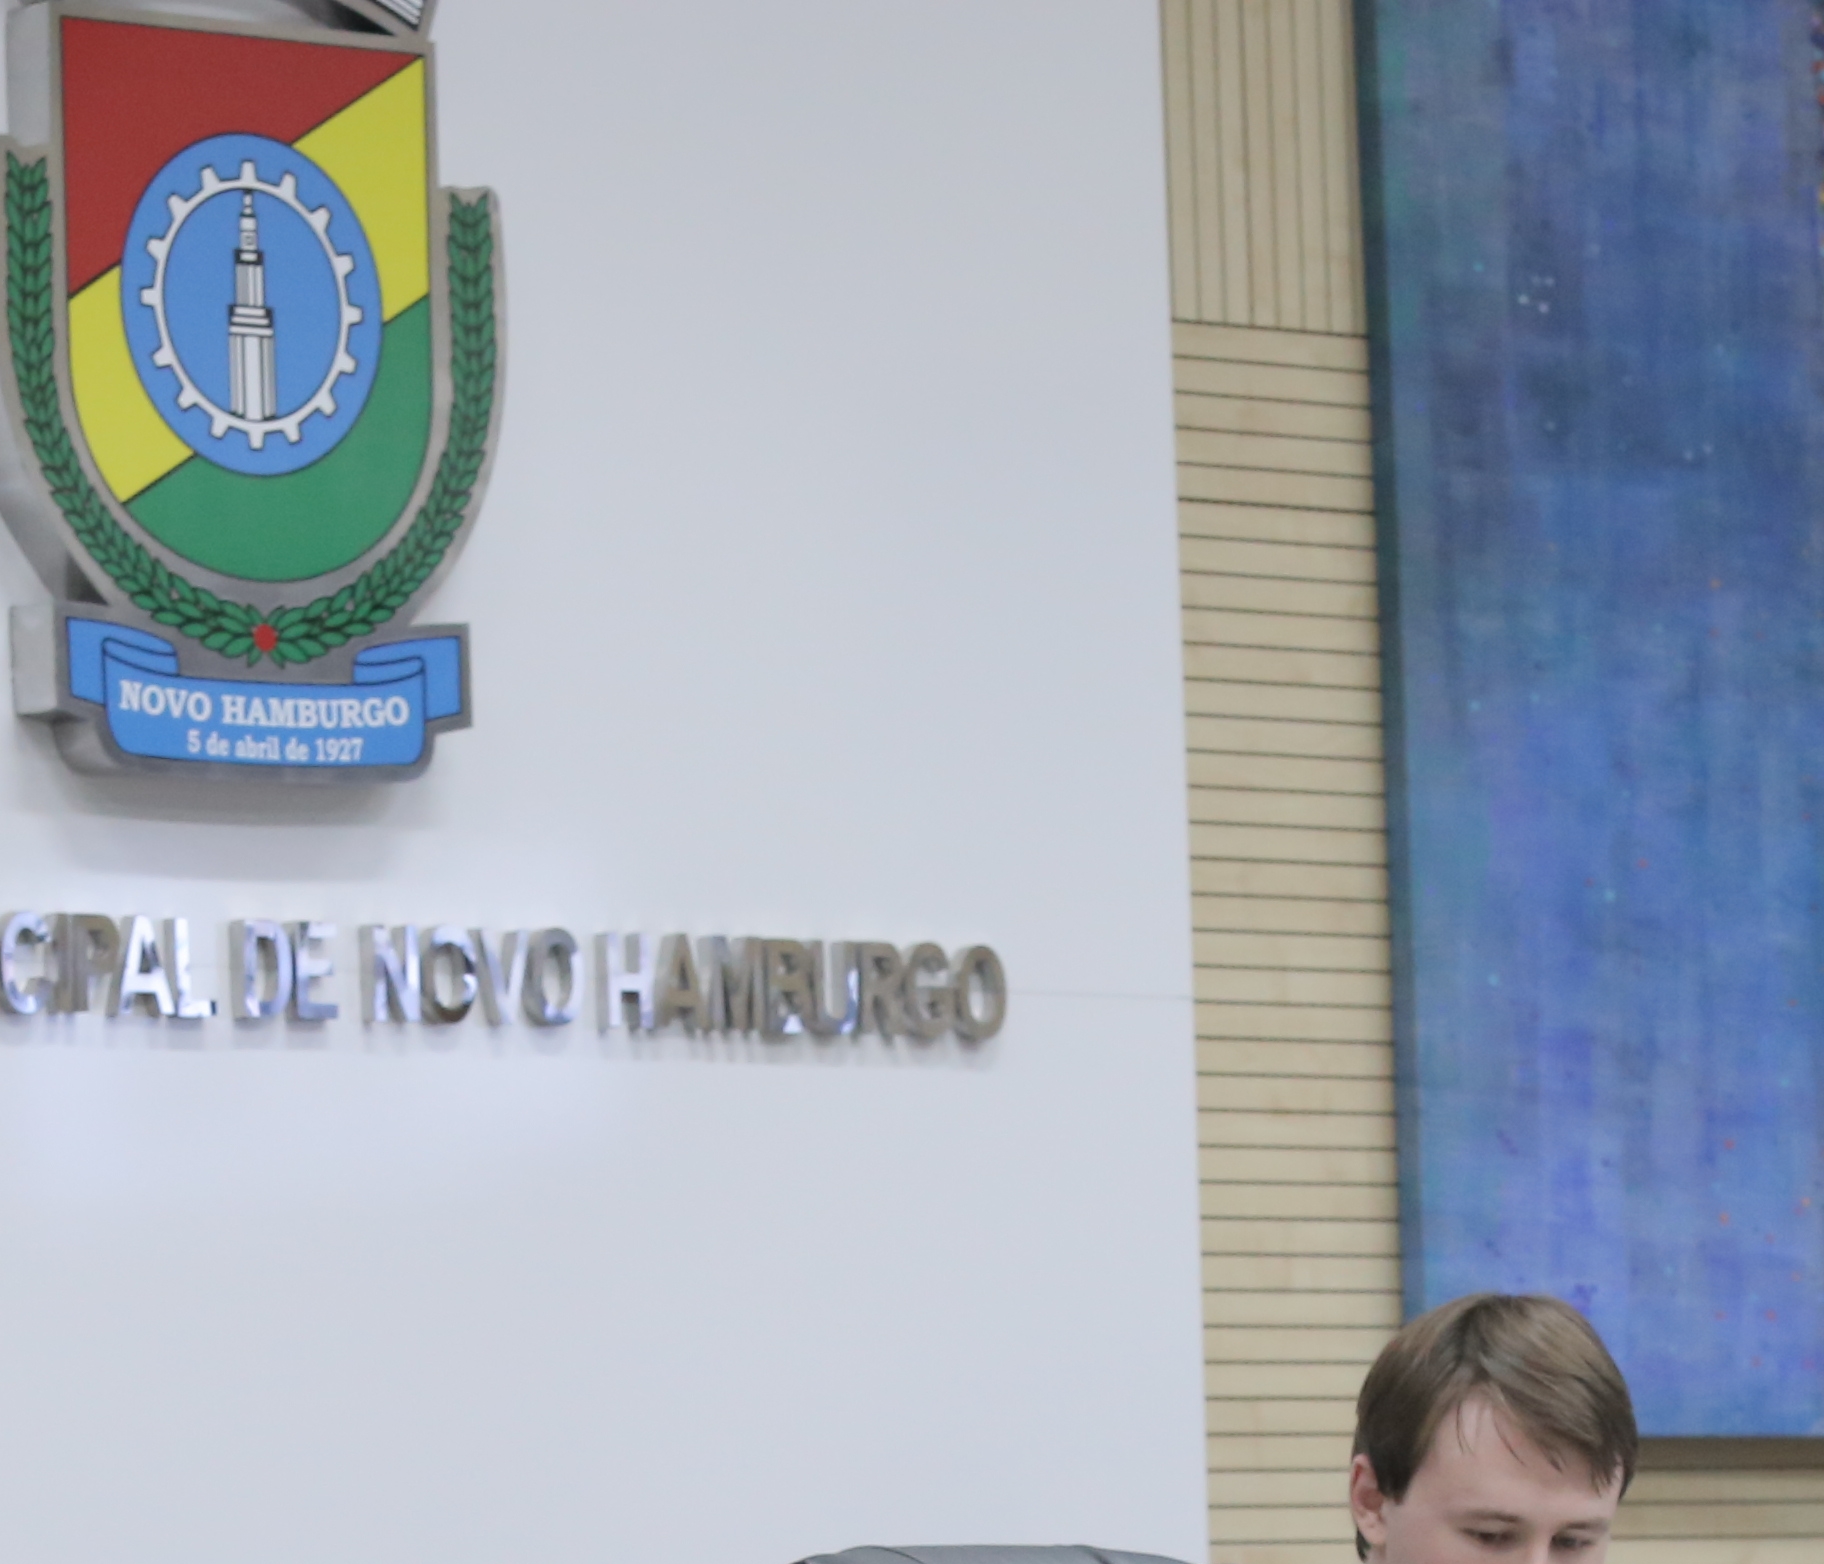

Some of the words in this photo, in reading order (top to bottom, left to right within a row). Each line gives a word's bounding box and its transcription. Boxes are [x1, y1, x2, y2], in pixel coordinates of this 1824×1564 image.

[119, 679, 213, 722] NOVO
[221, 695, 411, 729] HAMBURGO
[186, 728, 201, 754] 5
[205, 731, 230, 757] de
[234, 734, 281, 761] abril
[285, 736, 310, 762] de
[315, 737, 364, 762] 1927
[227, 918, 339, 1022] DE
[359, 922, 578, 1027] NOVO
[594, 932, 1008, 1040] HAMBURGO
